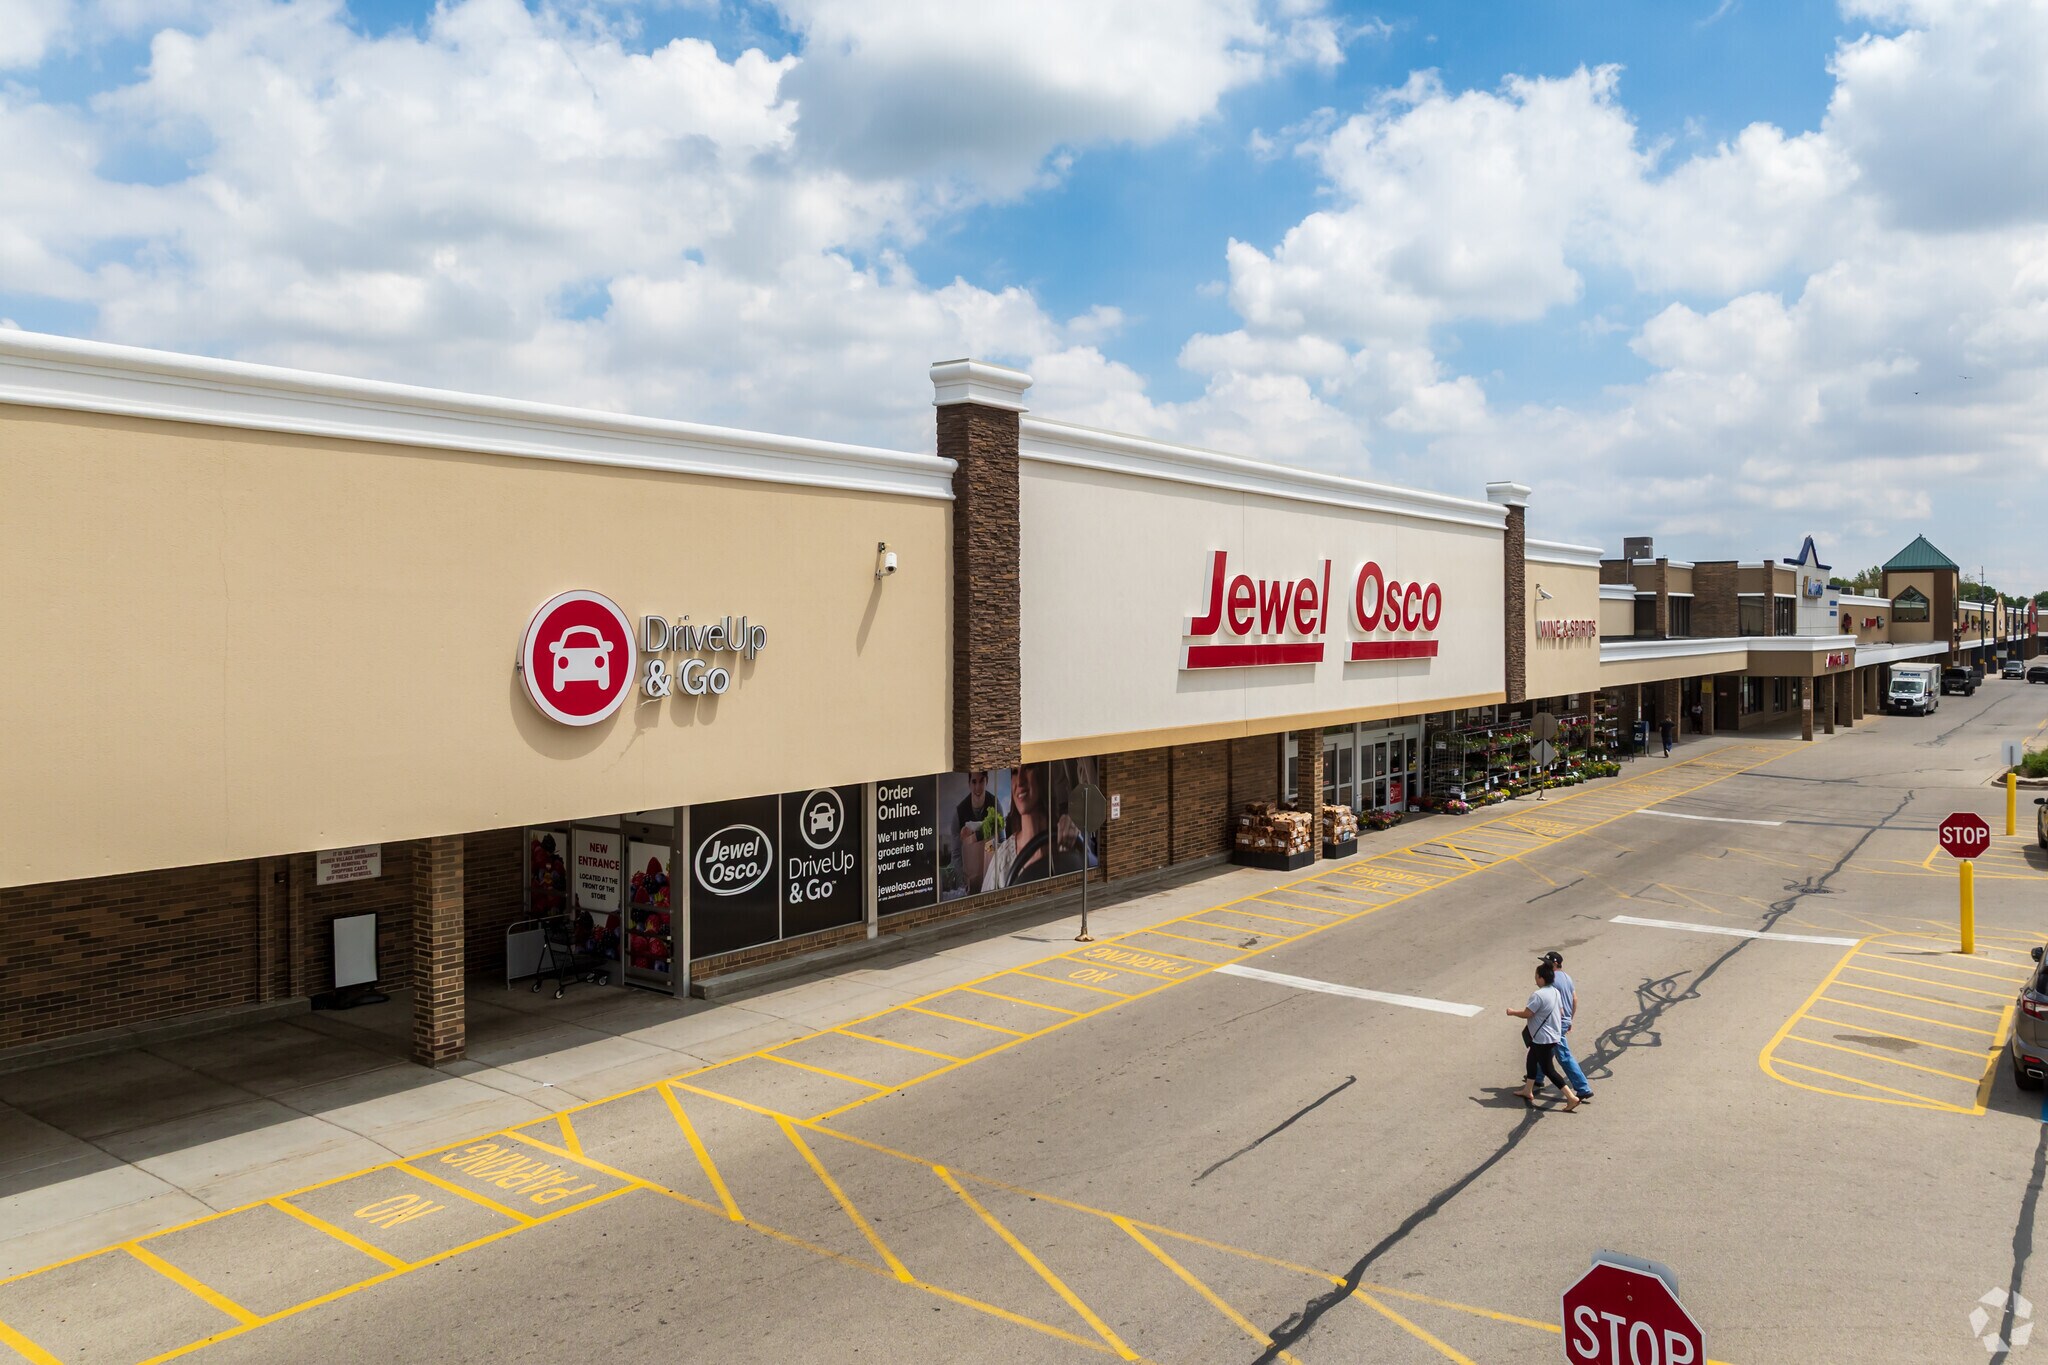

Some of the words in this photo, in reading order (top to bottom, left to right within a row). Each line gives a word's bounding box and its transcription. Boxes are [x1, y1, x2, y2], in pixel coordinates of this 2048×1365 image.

[1184, 549, 1332, 637] Jewel
[1349, 560, 1443, 634] Osco
[642, 615, 768, 660] DriveUp
[1538, 619, 1561, 638] WINE
[1562, 619, 1569, 638] &
[1570, 619, 1597, 638] SPIRITS
[642, 658, 672, 698] &
[677, 658, 730, 696] Go
[878, 784, 914, 802] Order
[878, 802, 921, 821] Online.
[877, 830, 897, 843] We'll
[899, 828, 919, 840] bring
[920, 826, 933, 836] the
[1942, 826, 1988, 845] STOP
[589, 842, 609, 854] NEW
[705, 836, 761, 864] Jewel
[877, 843, 915, 861] groceries
[916, 841, 924, 851] to
[578, 855, 620, 871] ENTRANCE
[789, 850, 855, 880] DriveUp
[877, 861, 896, 875] your
[897, 858, 912, 869] car.
[579, 872, 601, 883] LOCATED
[609, 877, 618, 885] THE
[1349, 866, 1437, 885] PARKING
[1351, 878, 1388, 889] NO
[582, 882, 598, 891] FRONT
[598, 884, 605, 892] OF
[606, 885, 615, 893] THE
[591, 891, 606, 900] STORE
[789, 882, 803, 904] &
[877, 876, 933, 898] jewelosco.com
[1083, 947, 1194, 976] PARKING
[1068, 968, 1119, 984] NO
[440, 1142, 598, 1206] PARKING
[354, 1193, 446, 1230] NO
[1573, 1304, 1695, 1365] STOP
